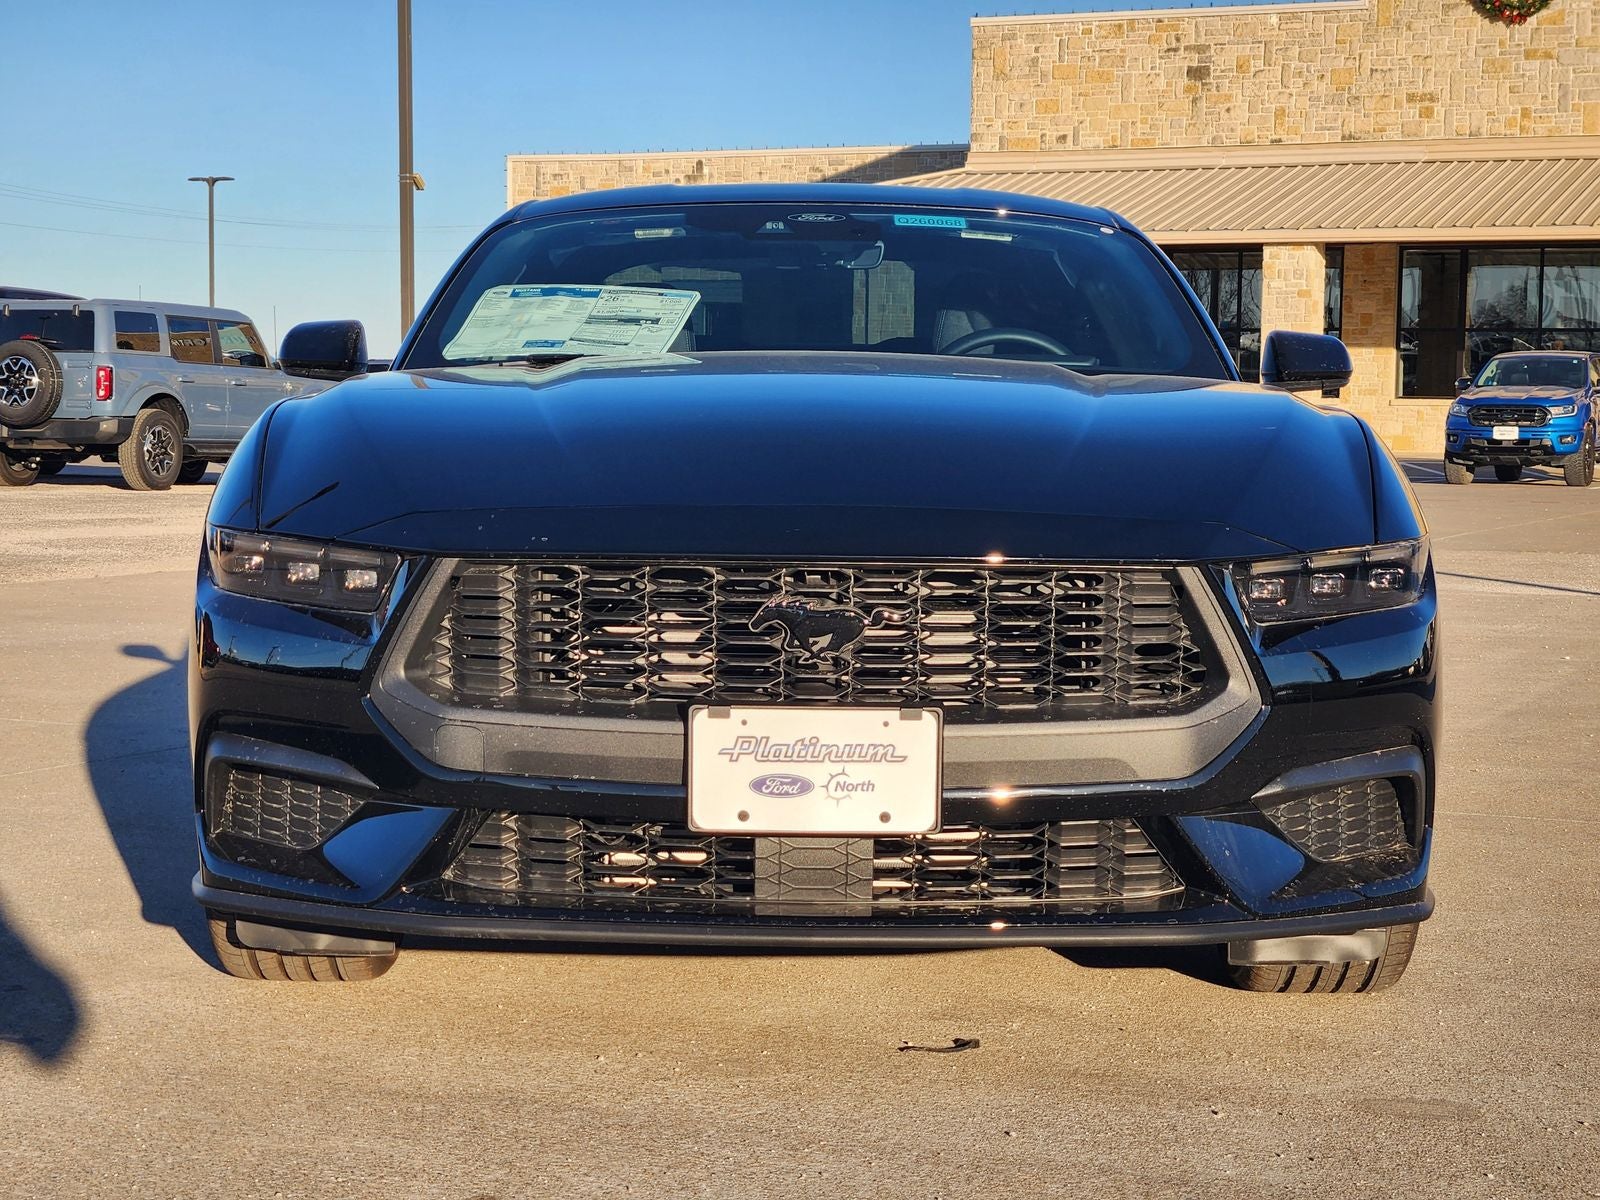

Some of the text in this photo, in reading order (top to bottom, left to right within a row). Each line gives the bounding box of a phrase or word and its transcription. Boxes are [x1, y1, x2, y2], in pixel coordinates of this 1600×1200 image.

[897, 216, 964, 228] Q260068
[718, 735, 908, 763] Platinum
[761, 777, 802, 795] Ford
[834, 779, 875, 793] North
